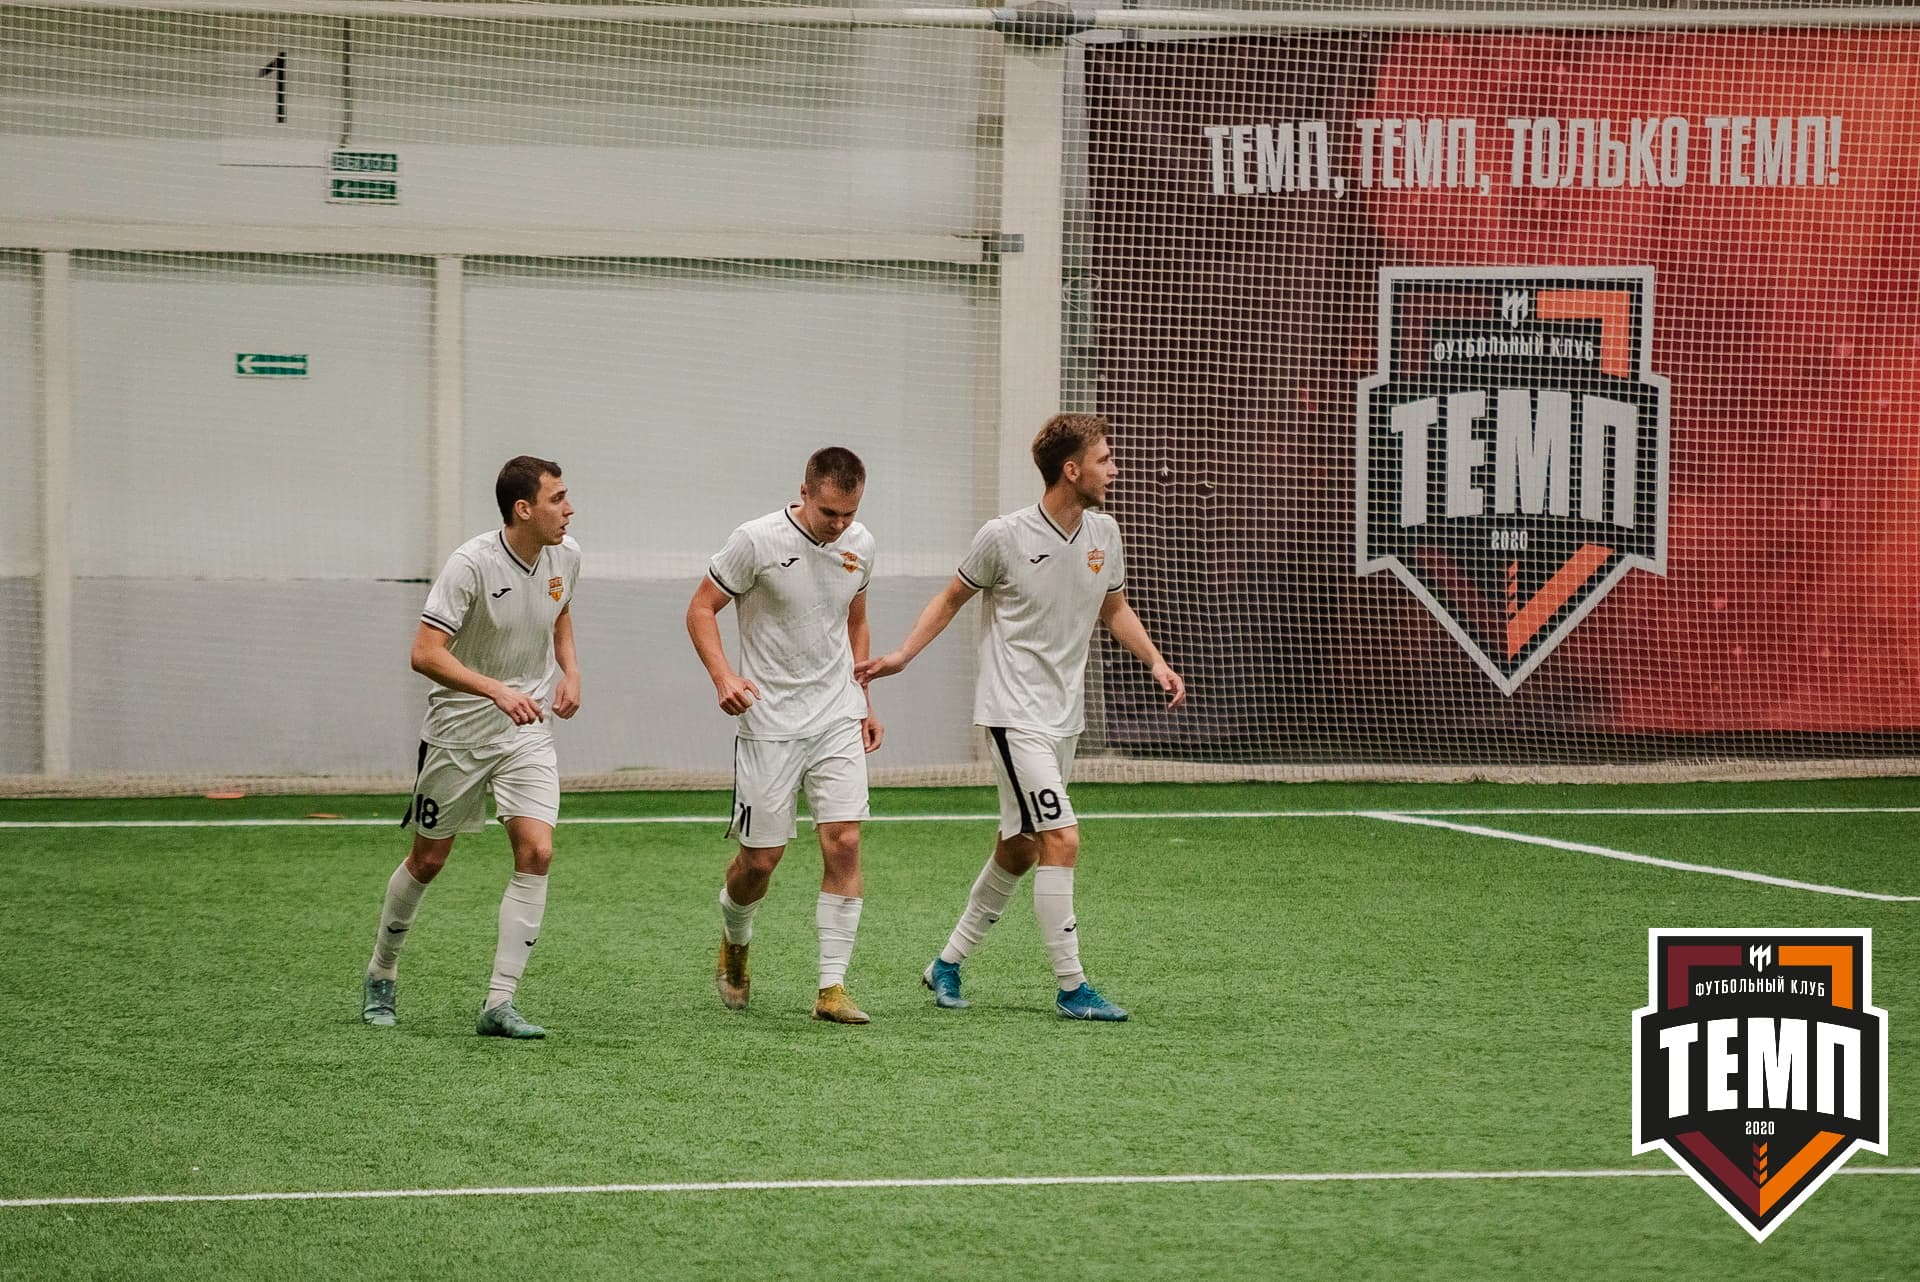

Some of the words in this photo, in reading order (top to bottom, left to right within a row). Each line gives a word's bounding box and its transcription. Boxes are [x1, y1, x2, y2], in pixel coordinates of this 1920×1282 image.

[258, 51, 287, 124] 1
[1204, 120, 1346, 199] ТЕМП,
[1356, 118, 1491, 196] ТЕМП,
[1507, 116, 1689, 190] ТОЛЬКО
[1705, 115, 1841, 187] ТЕМП!
[1434, 332, 1544, 361] ФУТБОЛЬНЫЙ
[1551, 335, 1594, 362] КЛУБ
[1391, 390, 1638, 530] ТЕМП
[1490, 530, 1529, 551] 2020
[415, 794, 440, 829] 18
[1029, 788, 1062, 823] 19
